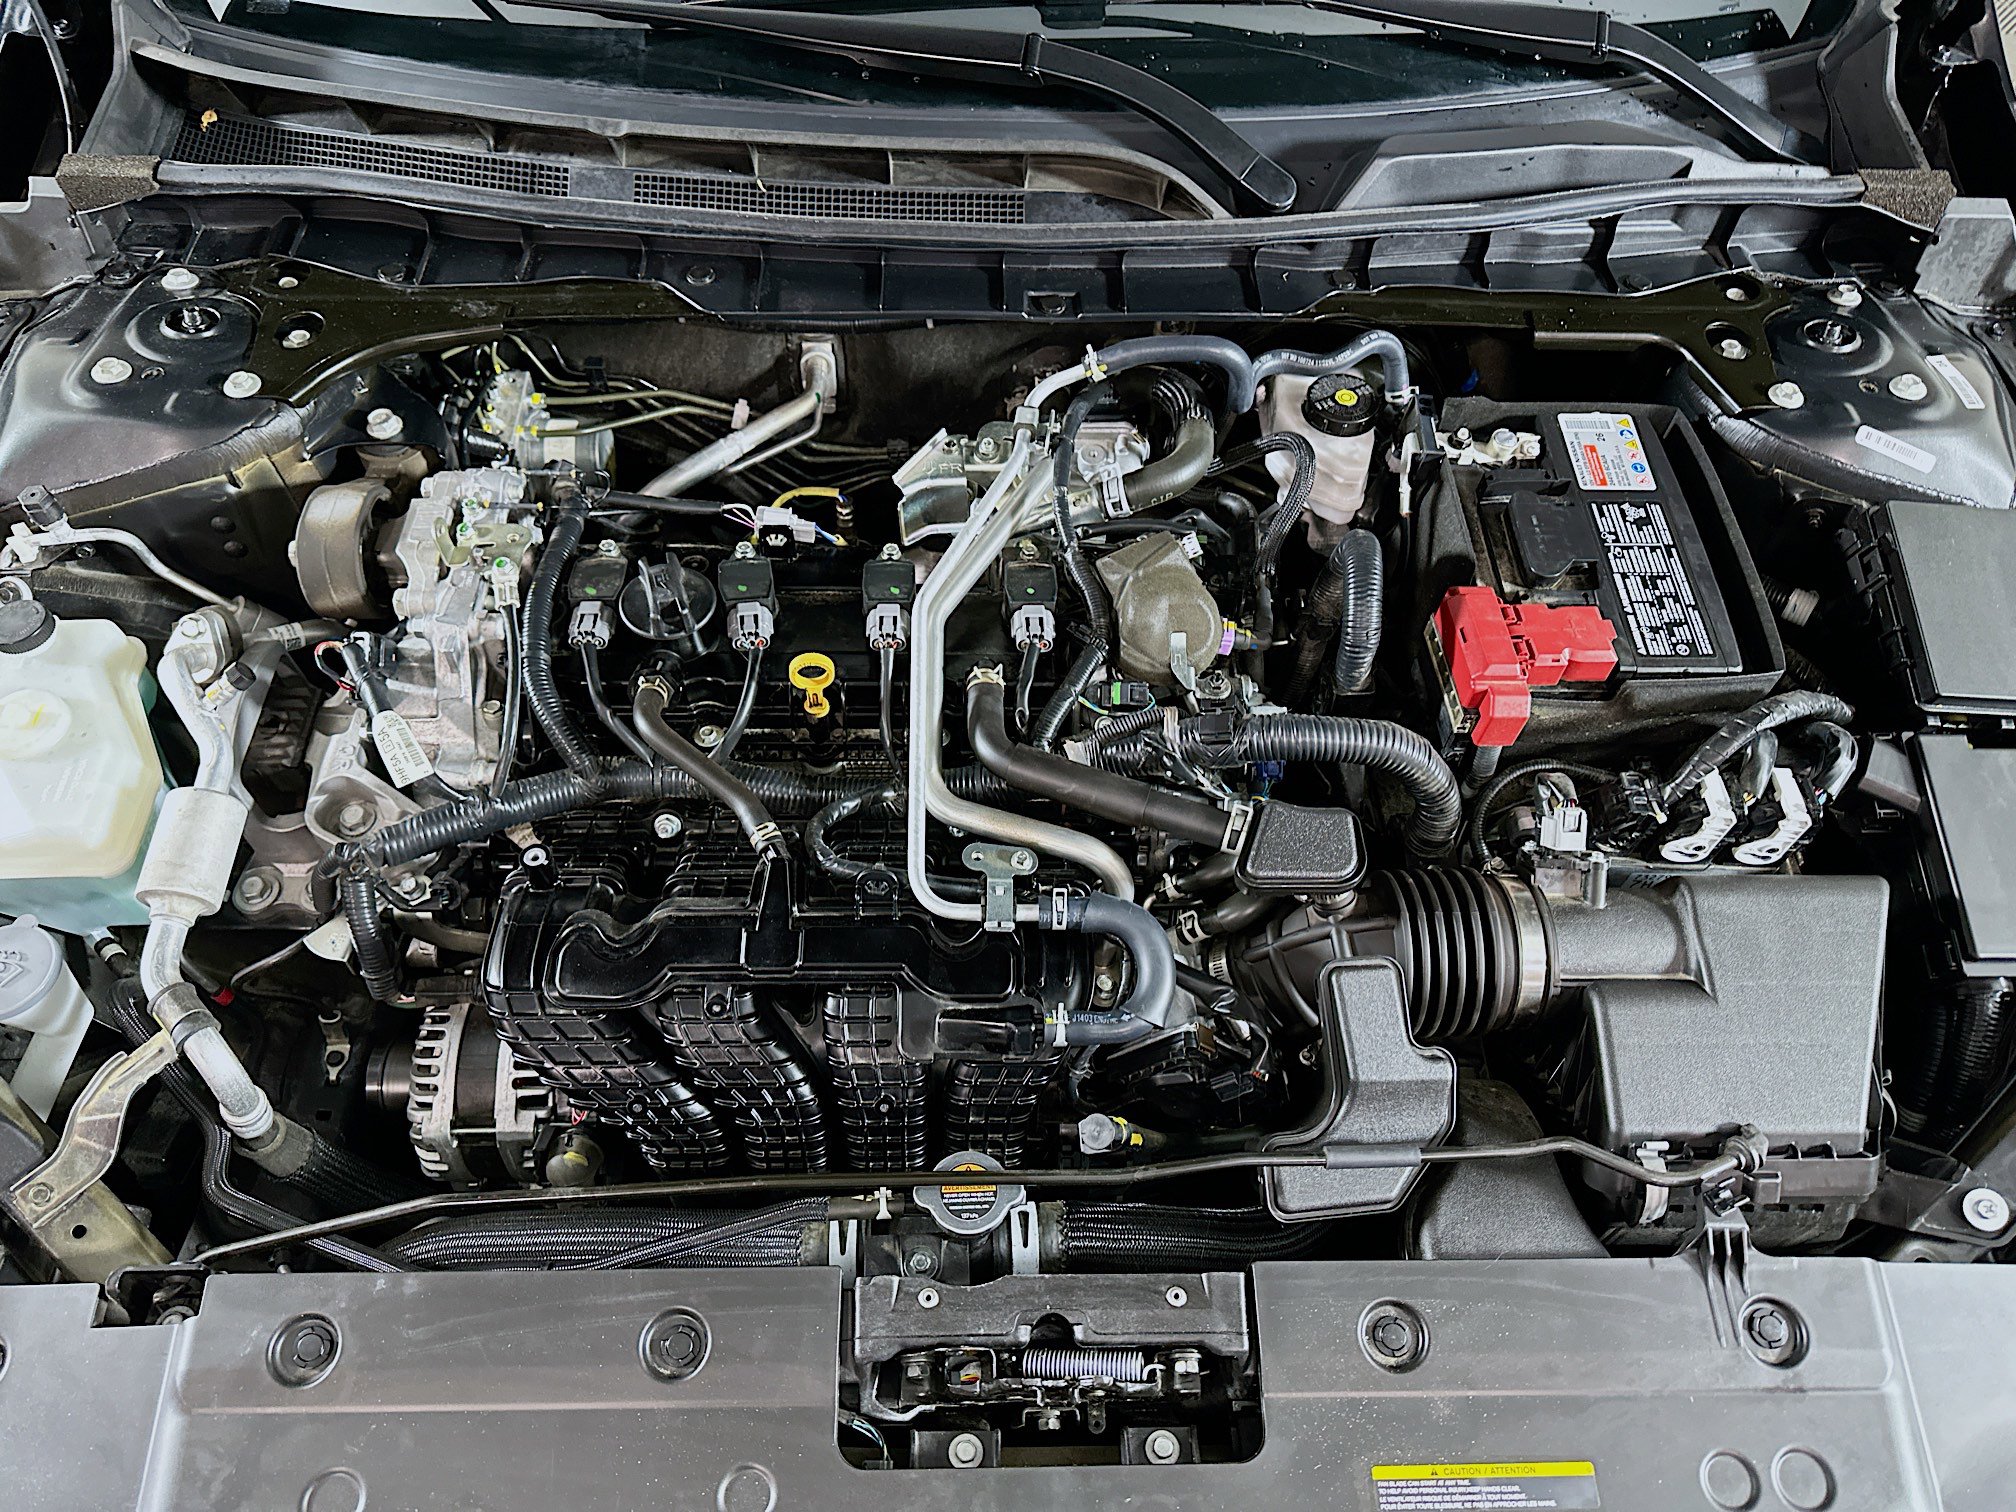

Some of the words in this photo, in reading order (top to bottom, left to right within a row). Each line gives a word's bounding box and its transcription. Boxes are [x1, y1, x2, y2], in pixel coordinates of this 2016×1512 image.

[1596, 433, 1606, 441] 26
[390, 753, 410, 784] 9HF5A
[1443, 1467, 1480, 1475] CAUTION
[1490, 1466, 1536, 1474] ATTENTION
